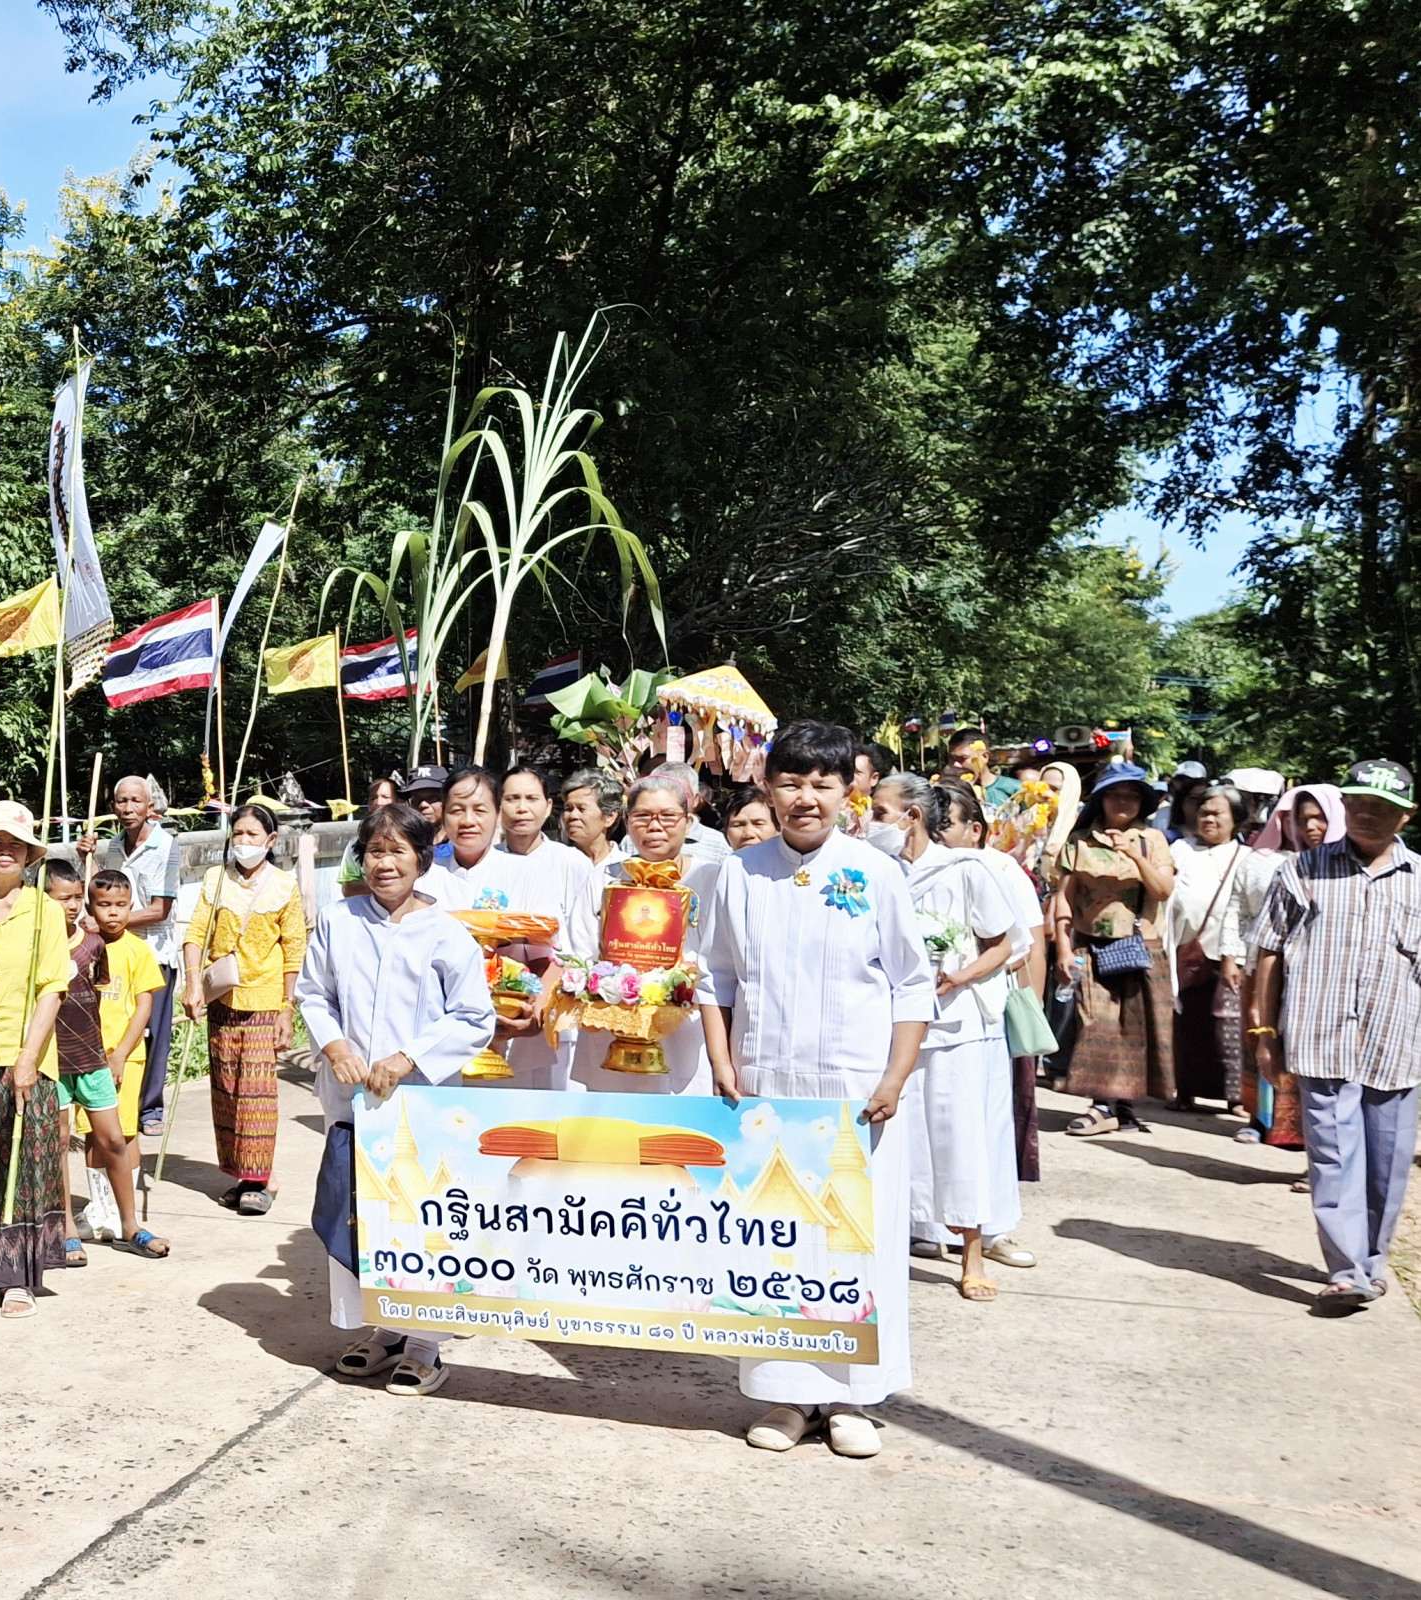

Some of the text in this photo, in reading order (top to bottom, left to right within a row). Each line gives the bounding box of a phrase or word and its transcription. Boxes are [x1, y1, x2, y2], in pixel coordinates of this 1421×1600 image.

[419, 1187, 798, 1248] กฐินสามัคคีทั่วไทย
[374, 1249, 860, 1305] ๓๐,๐๐๐ วัด พุทธศักราช ๒๕๖๘
[379, 1298, 856, 1352] โดย คณะศิษยานุศิษย์ บูชาธรรม ๘๑ ปี หลวงพ่อธัมมชโย
